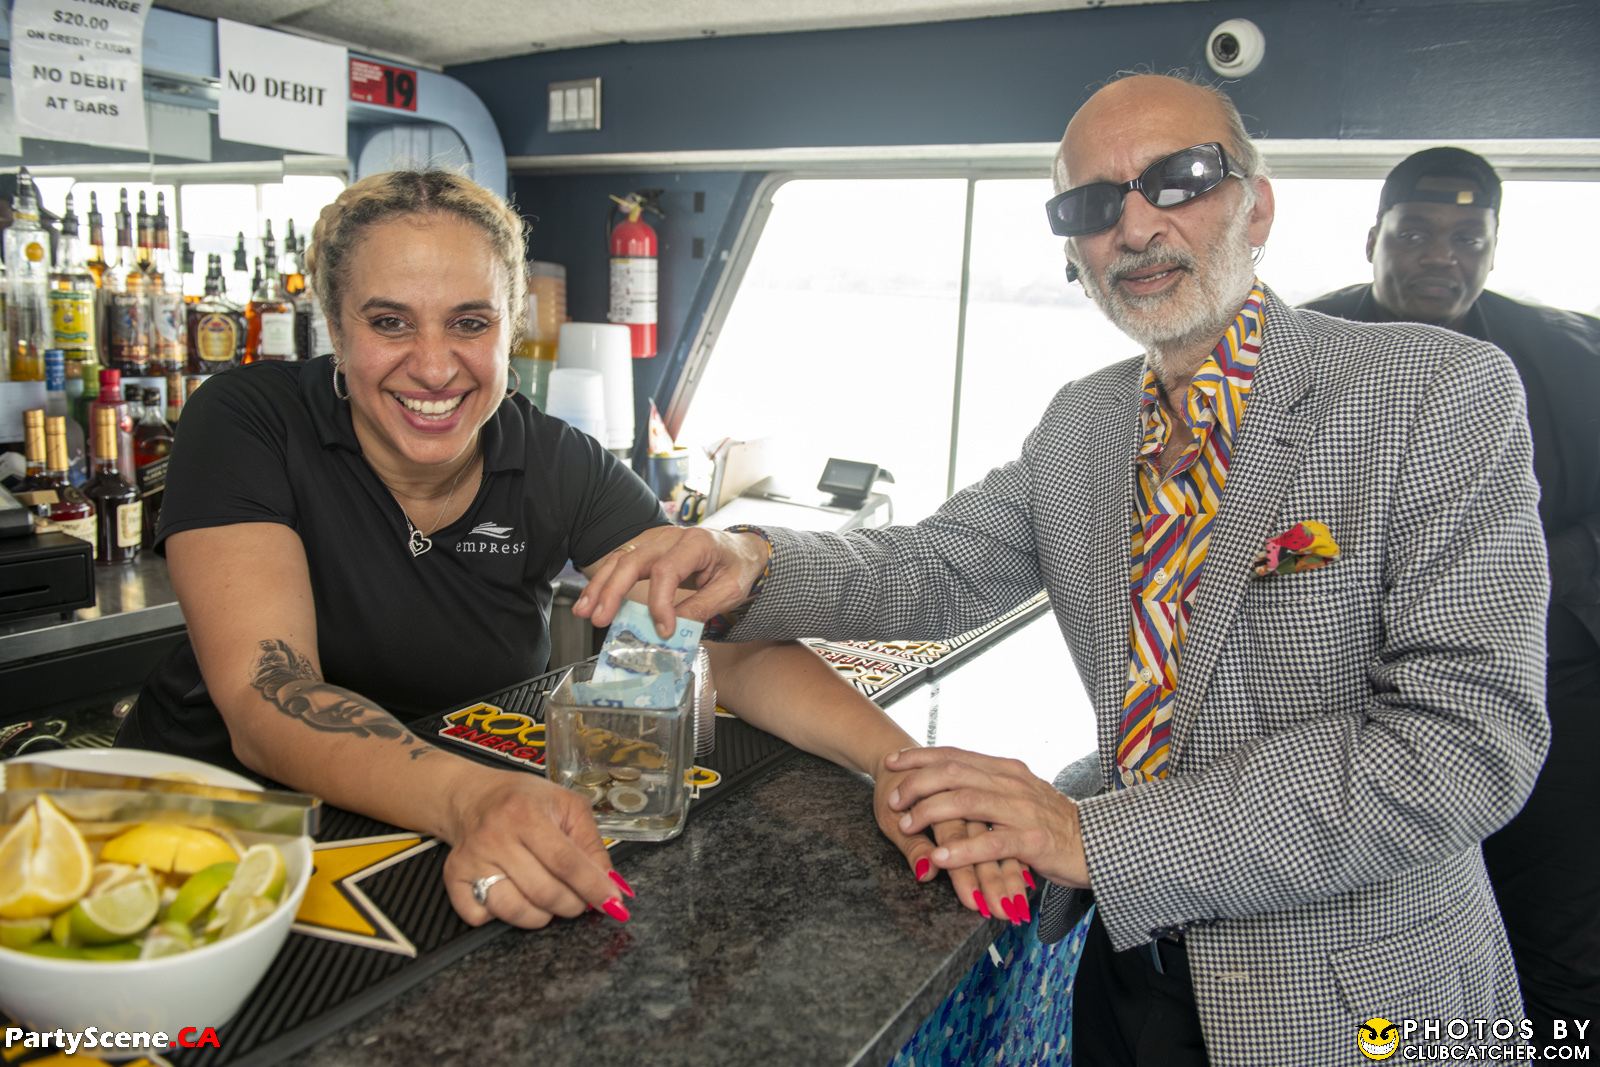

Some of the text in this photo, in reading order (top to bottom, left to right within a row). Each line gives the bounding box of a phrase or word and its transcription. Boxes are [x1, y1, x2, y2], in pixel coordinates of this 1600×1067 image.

[53, 10, 109, 31] $20.00
[27, 29, 45, 39] ON
[48, 33, 91, 46] CREDIT
[33, 65, 128, 92] NO DEBIT
[228, 69, 327, 106] NO DEBIT
[384, 69, 415, 107] 19
[46, 96, 119, 116] AT BARS
[441, 724, 546, 765] ENERG
